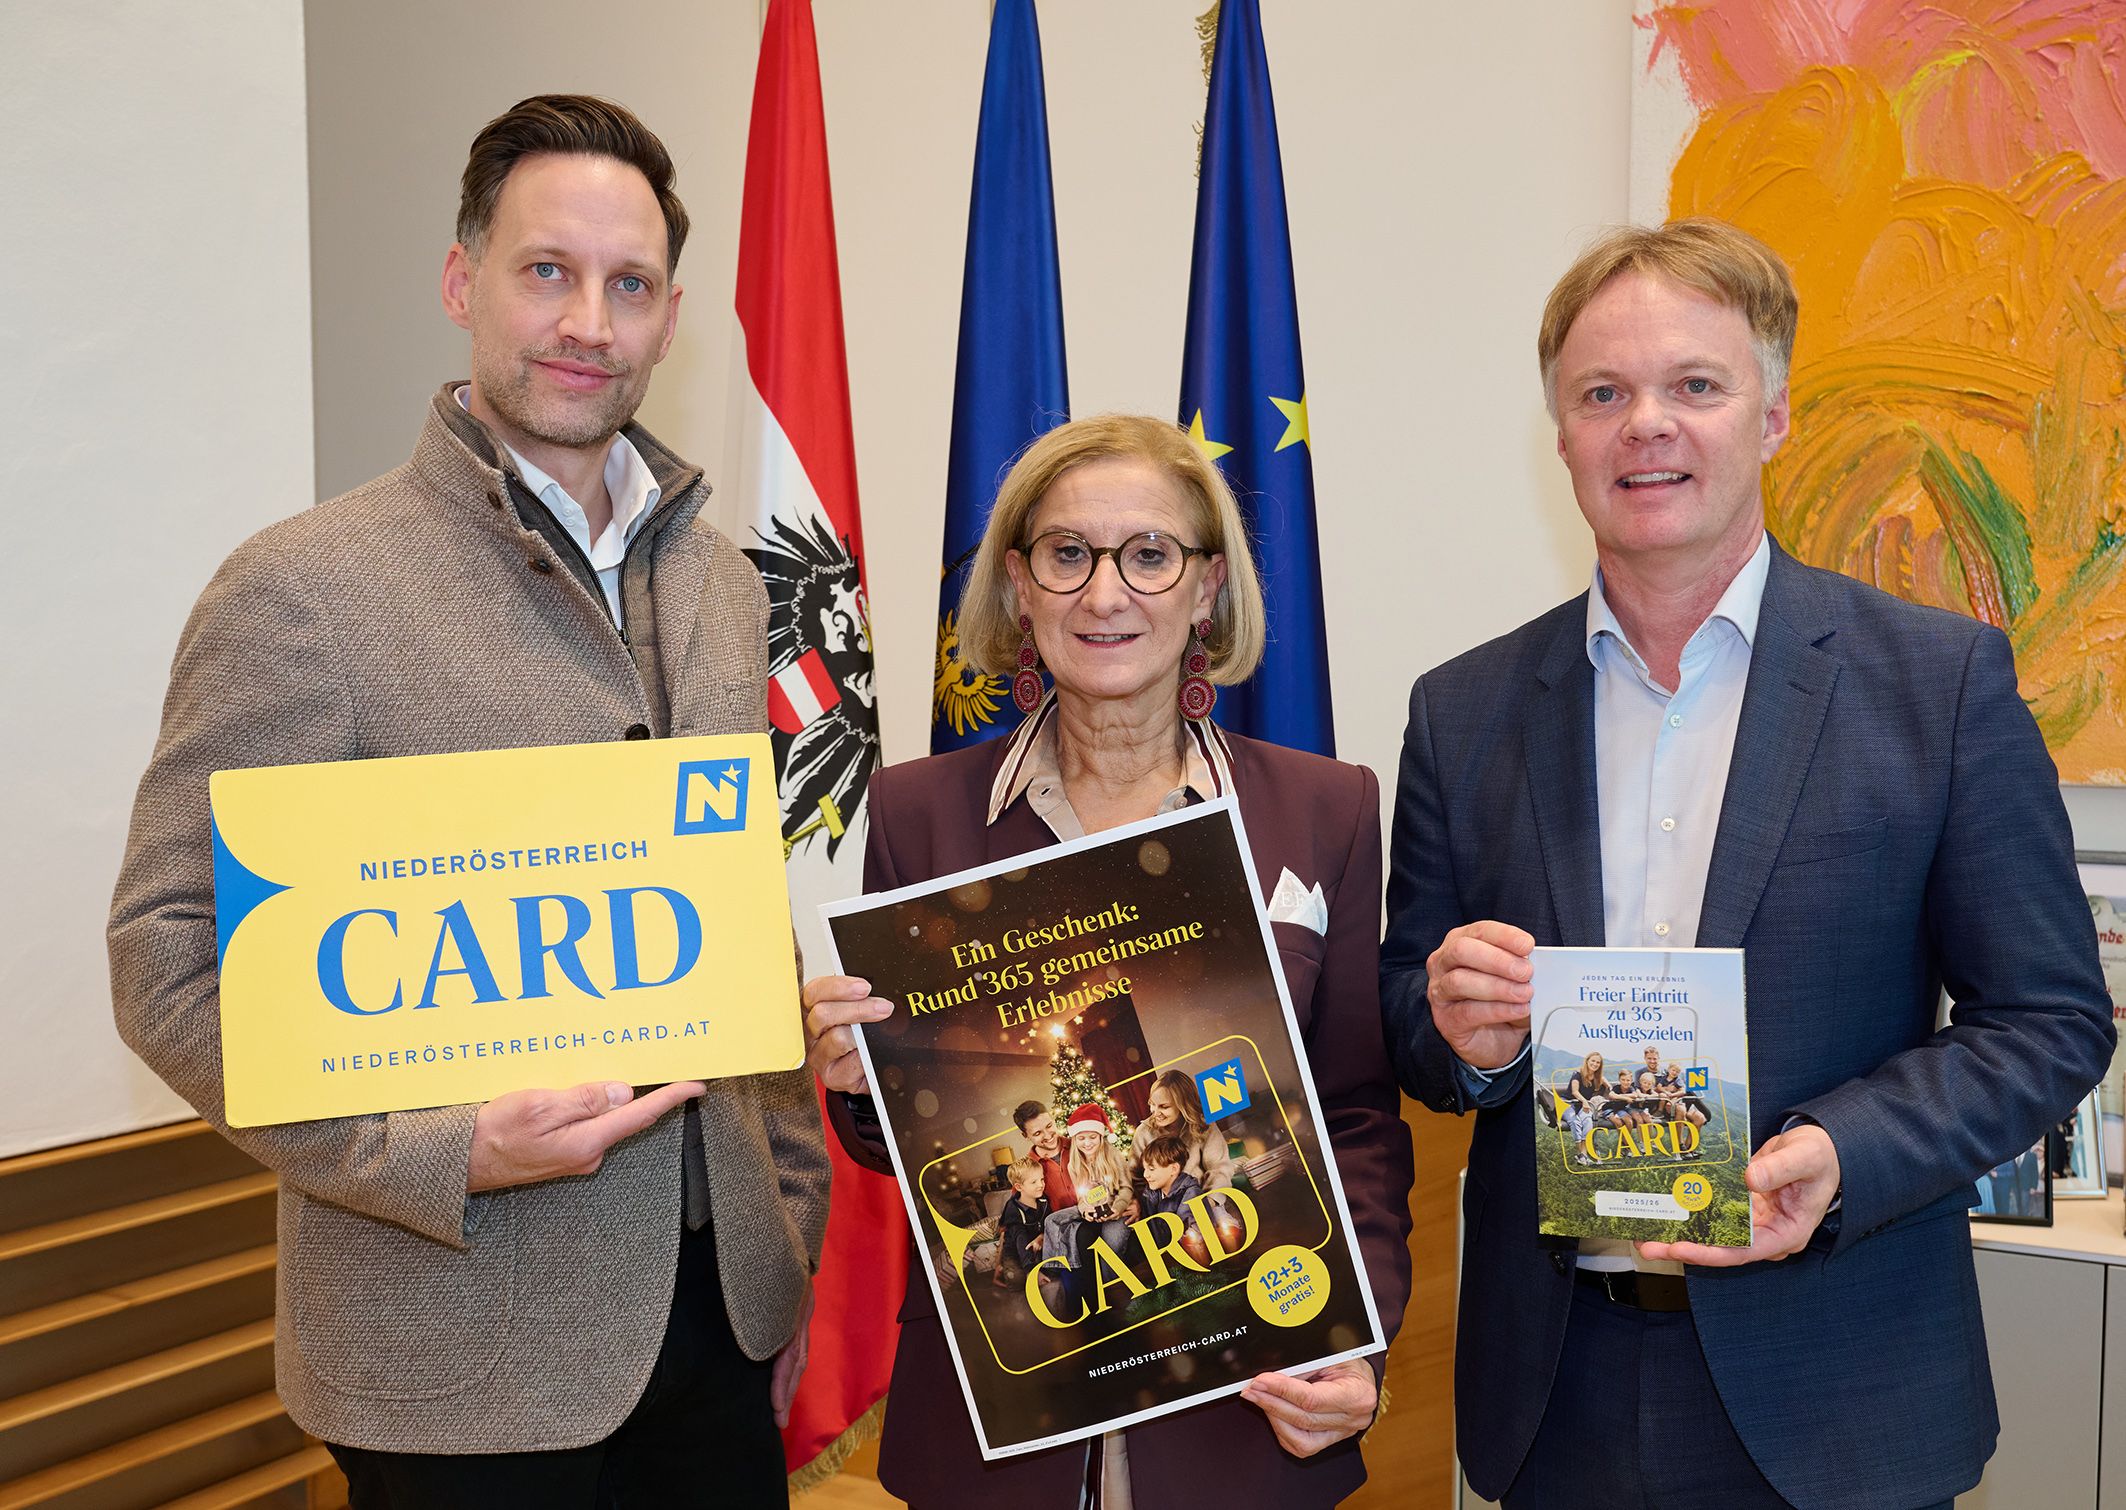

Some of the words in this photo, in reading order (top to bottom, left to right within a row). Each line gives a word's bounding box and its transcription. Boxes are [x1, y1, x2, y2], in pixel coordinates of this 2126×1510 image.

[359, 841, 648, 882] NIEDERÖSTERREICH
[317, 886, 703, 1016] CARD
[950, 942, 997, 969] Ein
[1002, 901, 1140, 953] Geschenk:
[906, 977, 978, 1018] Rund
[982, 962, 1034, 995] 365
[1040, 921, 1205, 987] gemeinsame
[996, 976, 1132, 1029] Erlebnisse
[1579, 986, 1626, 1002] Freier
[1632, 988, 1689, 1004] Eintritt
[1607, 1010, 1626, 1021] zu
[1631, 1006, 1662, 1021] 365
[322, 1020, 712, 1074] NIEDERÖSTERREICH-CARD.AT
[1578, 1024, 1694, 1043] Ausflugszielen
[1585, 1120, 1700, 1161] CARD
[1623, 1198, 1660, 1206] 2025/26
[1683, 1181, 1702, 1195] 20
[1025, 1187, 1259, 1329] CARD
[1259, 1256, 1303, 1290] 12+3
[1268, 1274, 1311, 1303] Monate
[1279, 1285, 1315, 1315] gratis!
[1088, 1325, 1248, 1378] NIEDERÖSTERREICH-CARD.AT
